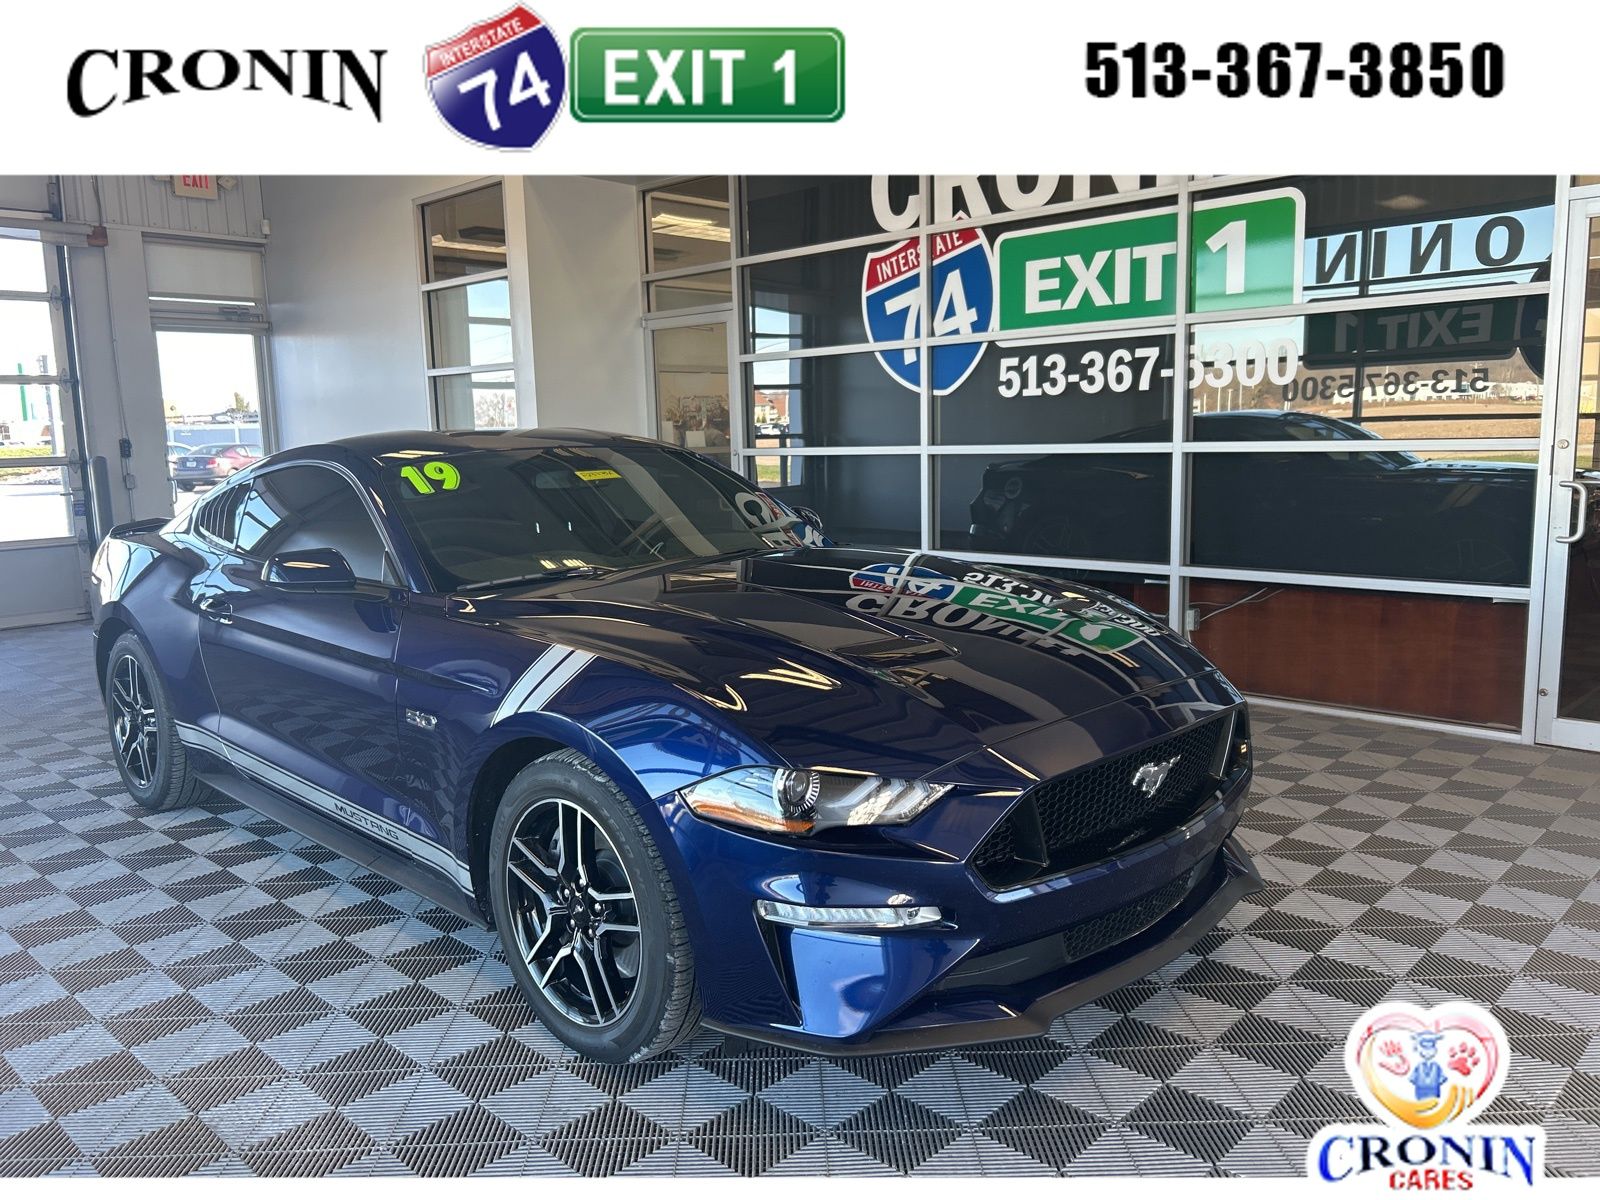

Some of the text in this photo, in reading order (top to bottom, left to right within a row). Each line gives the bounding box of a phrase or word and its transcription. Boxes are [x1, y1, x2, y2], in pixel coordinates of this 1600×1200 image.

[876, 231, 964, 283] INTERSATE
[1025, 219, 1247, 315] EXIT 1
[884, 268, 978, 366] 74
[400, 462, 462, 495] 19
[334, 802, 399, 841] MUSTANG
